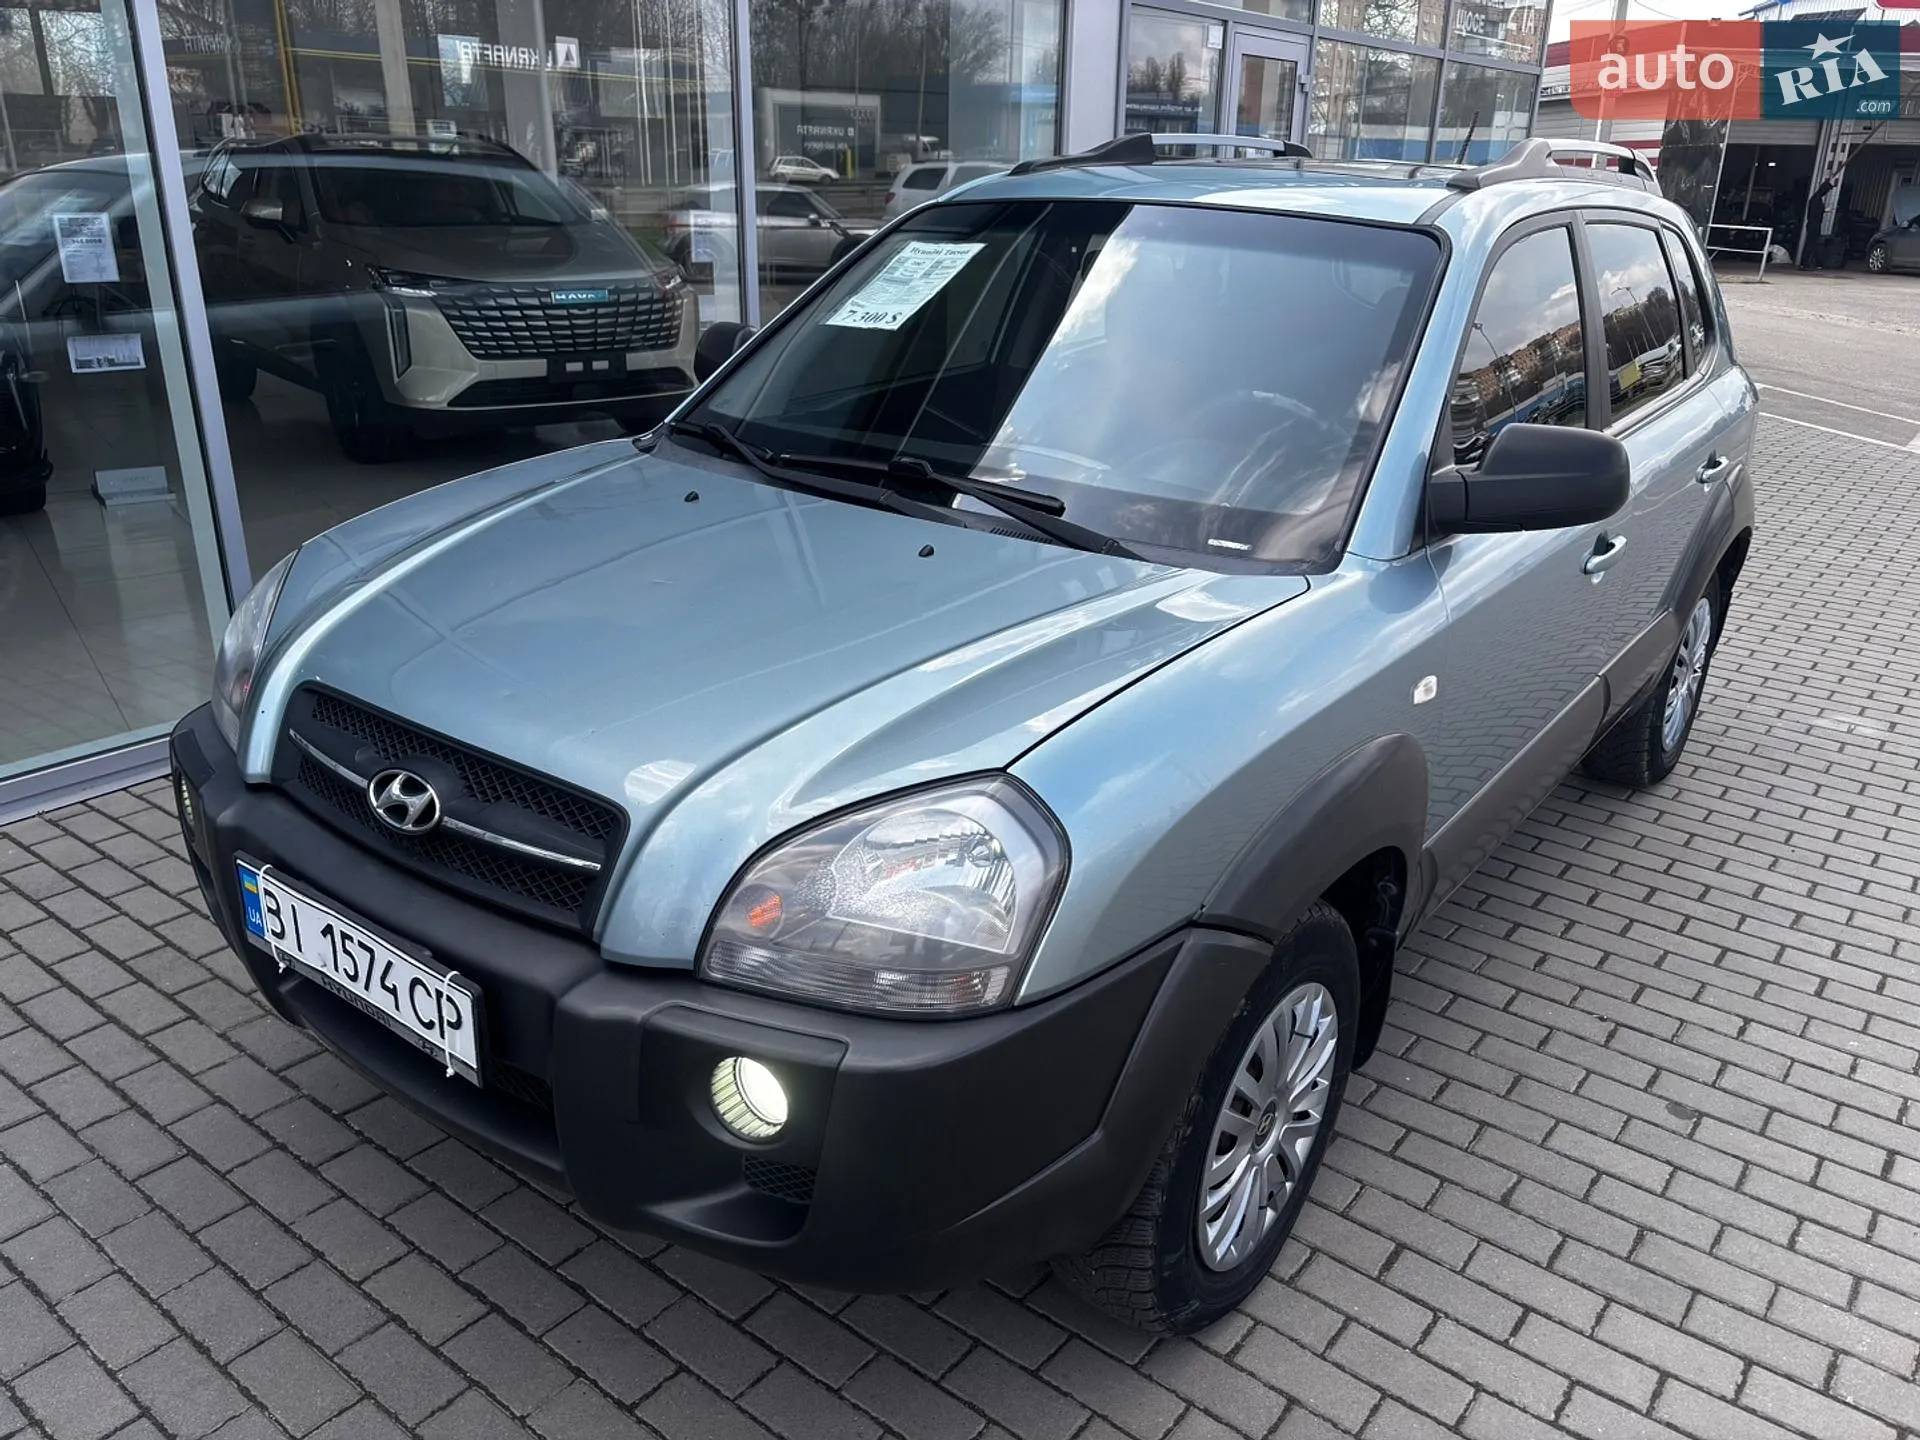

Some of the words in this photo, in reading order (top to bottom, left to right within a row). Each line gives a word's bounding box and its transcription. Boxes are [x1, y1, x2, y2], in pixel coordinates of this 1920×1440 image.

[249, 909, 263, 928] UA
[264, 886, 303, 953] BI
[320, 922, 400, 1014] 1574
[409, 974, 463, 1040] CP
